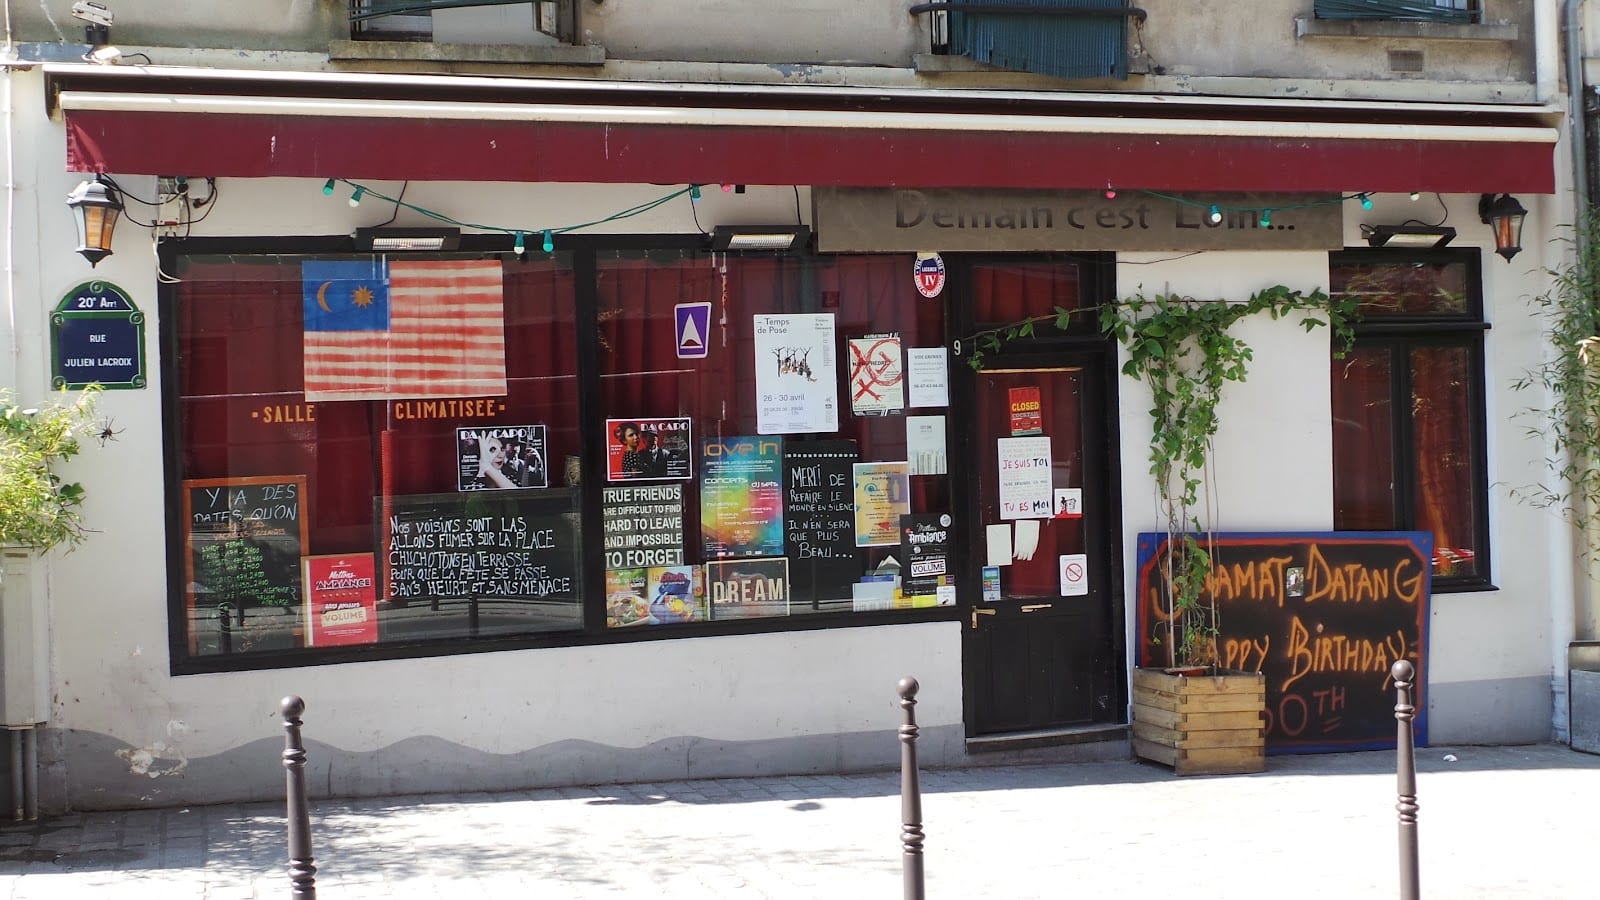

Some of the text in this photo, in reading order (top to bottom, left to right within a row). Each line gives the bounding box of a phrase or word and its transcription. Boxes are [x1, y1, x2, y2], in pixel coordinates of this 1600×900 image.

[896, 190, 1051, 229] Demain
[925, 275, 937, 286] IV
[763, 317, 790, 328] Temps
[757, 326, 788, 334] de Pose
[89, 334, 107, 343] RUE
[953, 339, 961, 356] 9
[64, 357, 132, 367] JULIEN LACROIX
[763, 394, 773, 402] 26
[778, 394, 789, 402] 30
[789, 393, 805, 402] avril
[263, 404, 316, 423] SALLE
[1011, 401, 1040, 412] CLOSED
[640, 421, 689, 432] DA CAPO
[460, 428, 527, 441] DA CAPO
[703, 440, 779, 457] love in
[1003, 457, 1048, 470] JE SUIS TOI
[829, 473, 846, 487] DE
[205, 484, 297, 508] Y A DES
[603, 487, 681, 503] TRUE FRIENDS
[789, 488, 823, 504] REFAIRE
[830, 491, 842, 502] LE
[618, 504, 653, 516] DIFFICULT
[654, 504, 664, 514] TO
[665, 503, 681, 513] FIND
[788, 503, 816, 512] MONDE
[1003, 499, 1049, 513] TU ES MOI
[193, 509, 243, 524] DATES
[465, 517, 493, 533] SONT
[501, 516, 527, 533] LAS
[603, 516, 682, 533] HARD TO LEAVE
[788, 519, 800, 530] IL
[827, 520, 851, 530] SERA
[389, 530, 556, 551] ALLONS FUMER SUR LA PLACE
[604, 532, 683, 549] AND IMPOSSIBLE
[789, 530, 840, 543] QUE PLUS
[388, 550, 533, 571] CHUCHOTONS EN TERRASSE
[604, 551, 623, 568] TO
[626, 548, 684, 567] FORGET
[417, 567, 439, 582] QUE
[441, 568, 456, 581] LA
[491, 567, 510, 580] SE
[911, 562, 945, 573] VOLUME
[428, 580, 468, 596] HEURT
[471, 580, 485, 594] ET
[486, 580, 519, 595] SANS
[519, 577, 571, 597] MENACE
[1151, 543, 1423, 622] SAMAT DATANG
[713, 577, 784, 604] DREAM
[323, 610, 364, 622] VOLUME
